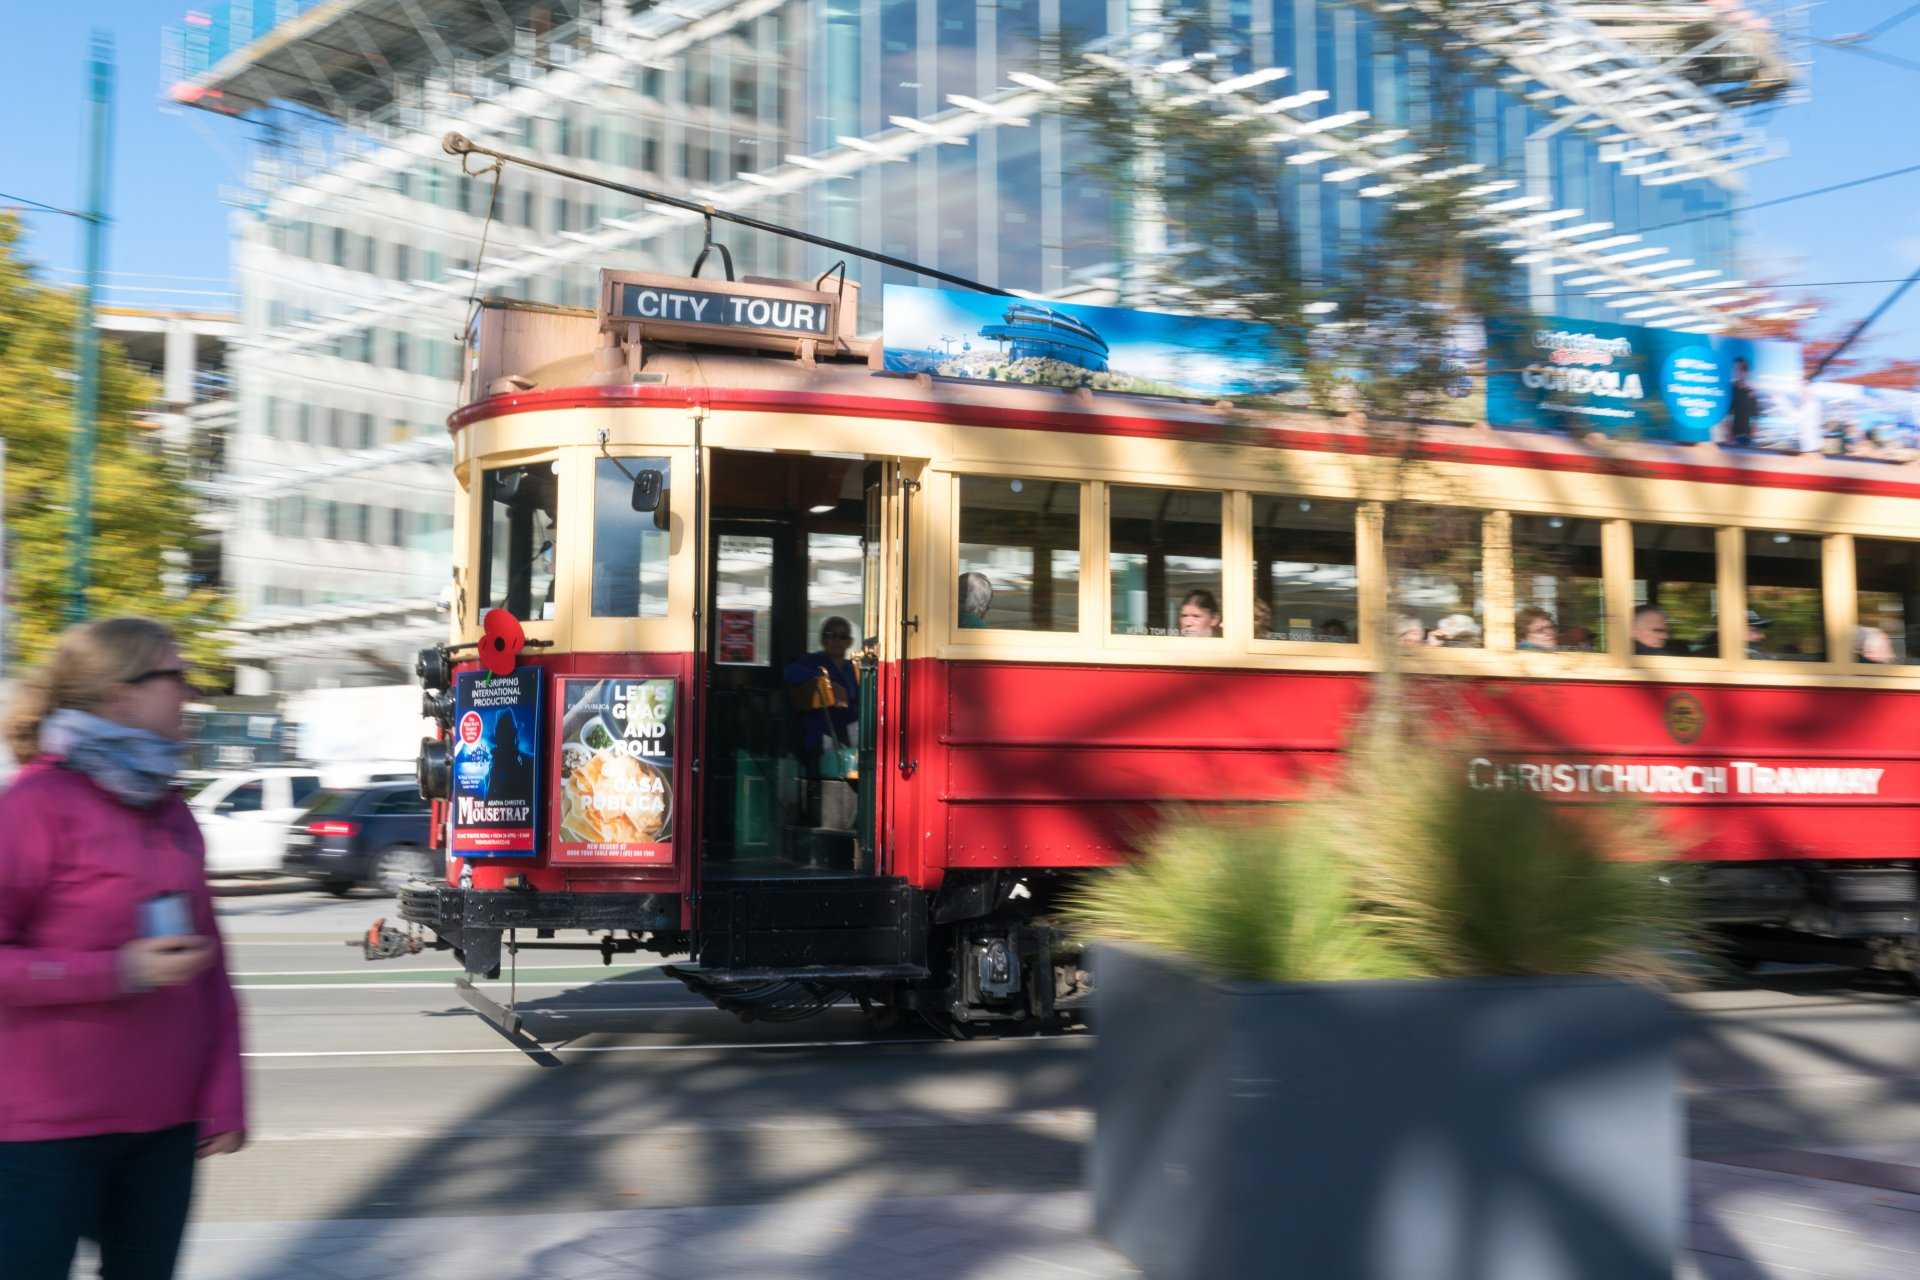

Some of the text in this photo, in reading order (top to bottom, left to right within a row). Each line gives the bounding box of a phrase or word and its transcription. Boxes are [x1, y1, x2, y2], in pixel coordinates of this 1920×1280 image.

[637, 291, 709, 321] CITY
[471, 687, 521, 698] INTERNATIONAL
[475, 680, 487, 688] THE
[473, 696, 518, 707] PRODUCTION!
[612, 702, 667, 720] GUAC
[623, 722, 667, 738] AND
[614, 740, 666, 757] ROLL
[1468, 758, 1886, 794] CHRISTCHURCH TRAMWAY
[458, 796, 530, 825] MOUSETRAP
